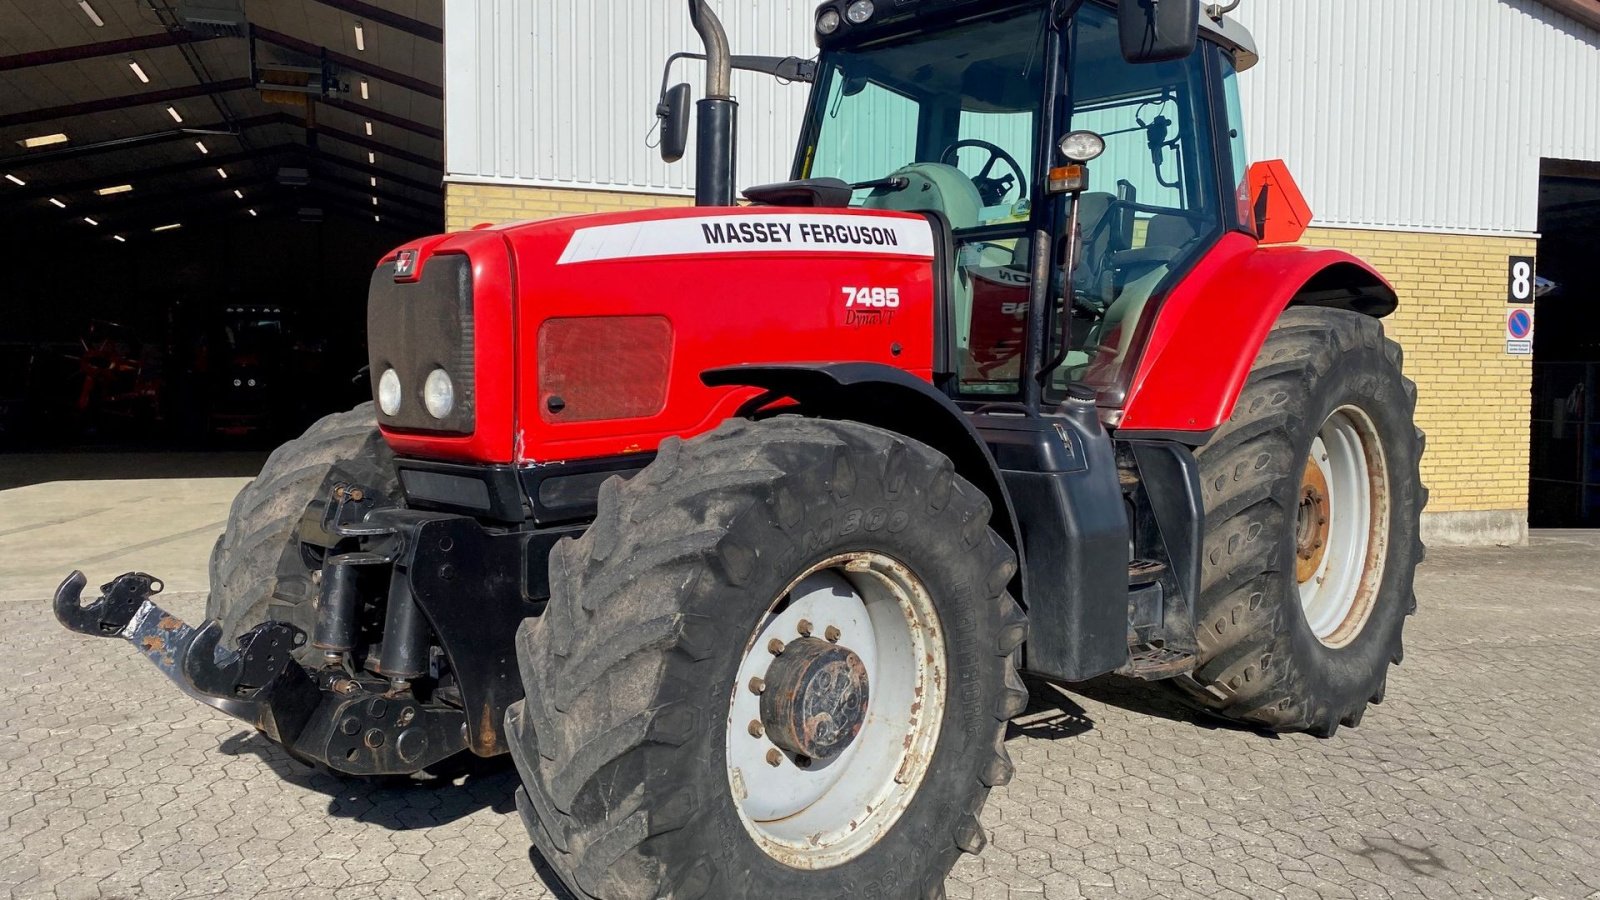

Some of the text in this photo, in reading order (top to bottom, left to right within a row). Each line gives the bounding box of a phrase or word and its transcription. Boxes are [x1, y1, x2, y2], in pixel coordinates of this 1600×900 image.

[701, 222, 899, 246] MASSEY FERGUSON
[1512, 261, 1531, 299] 8
[841, 286, 900, 308] 7485
